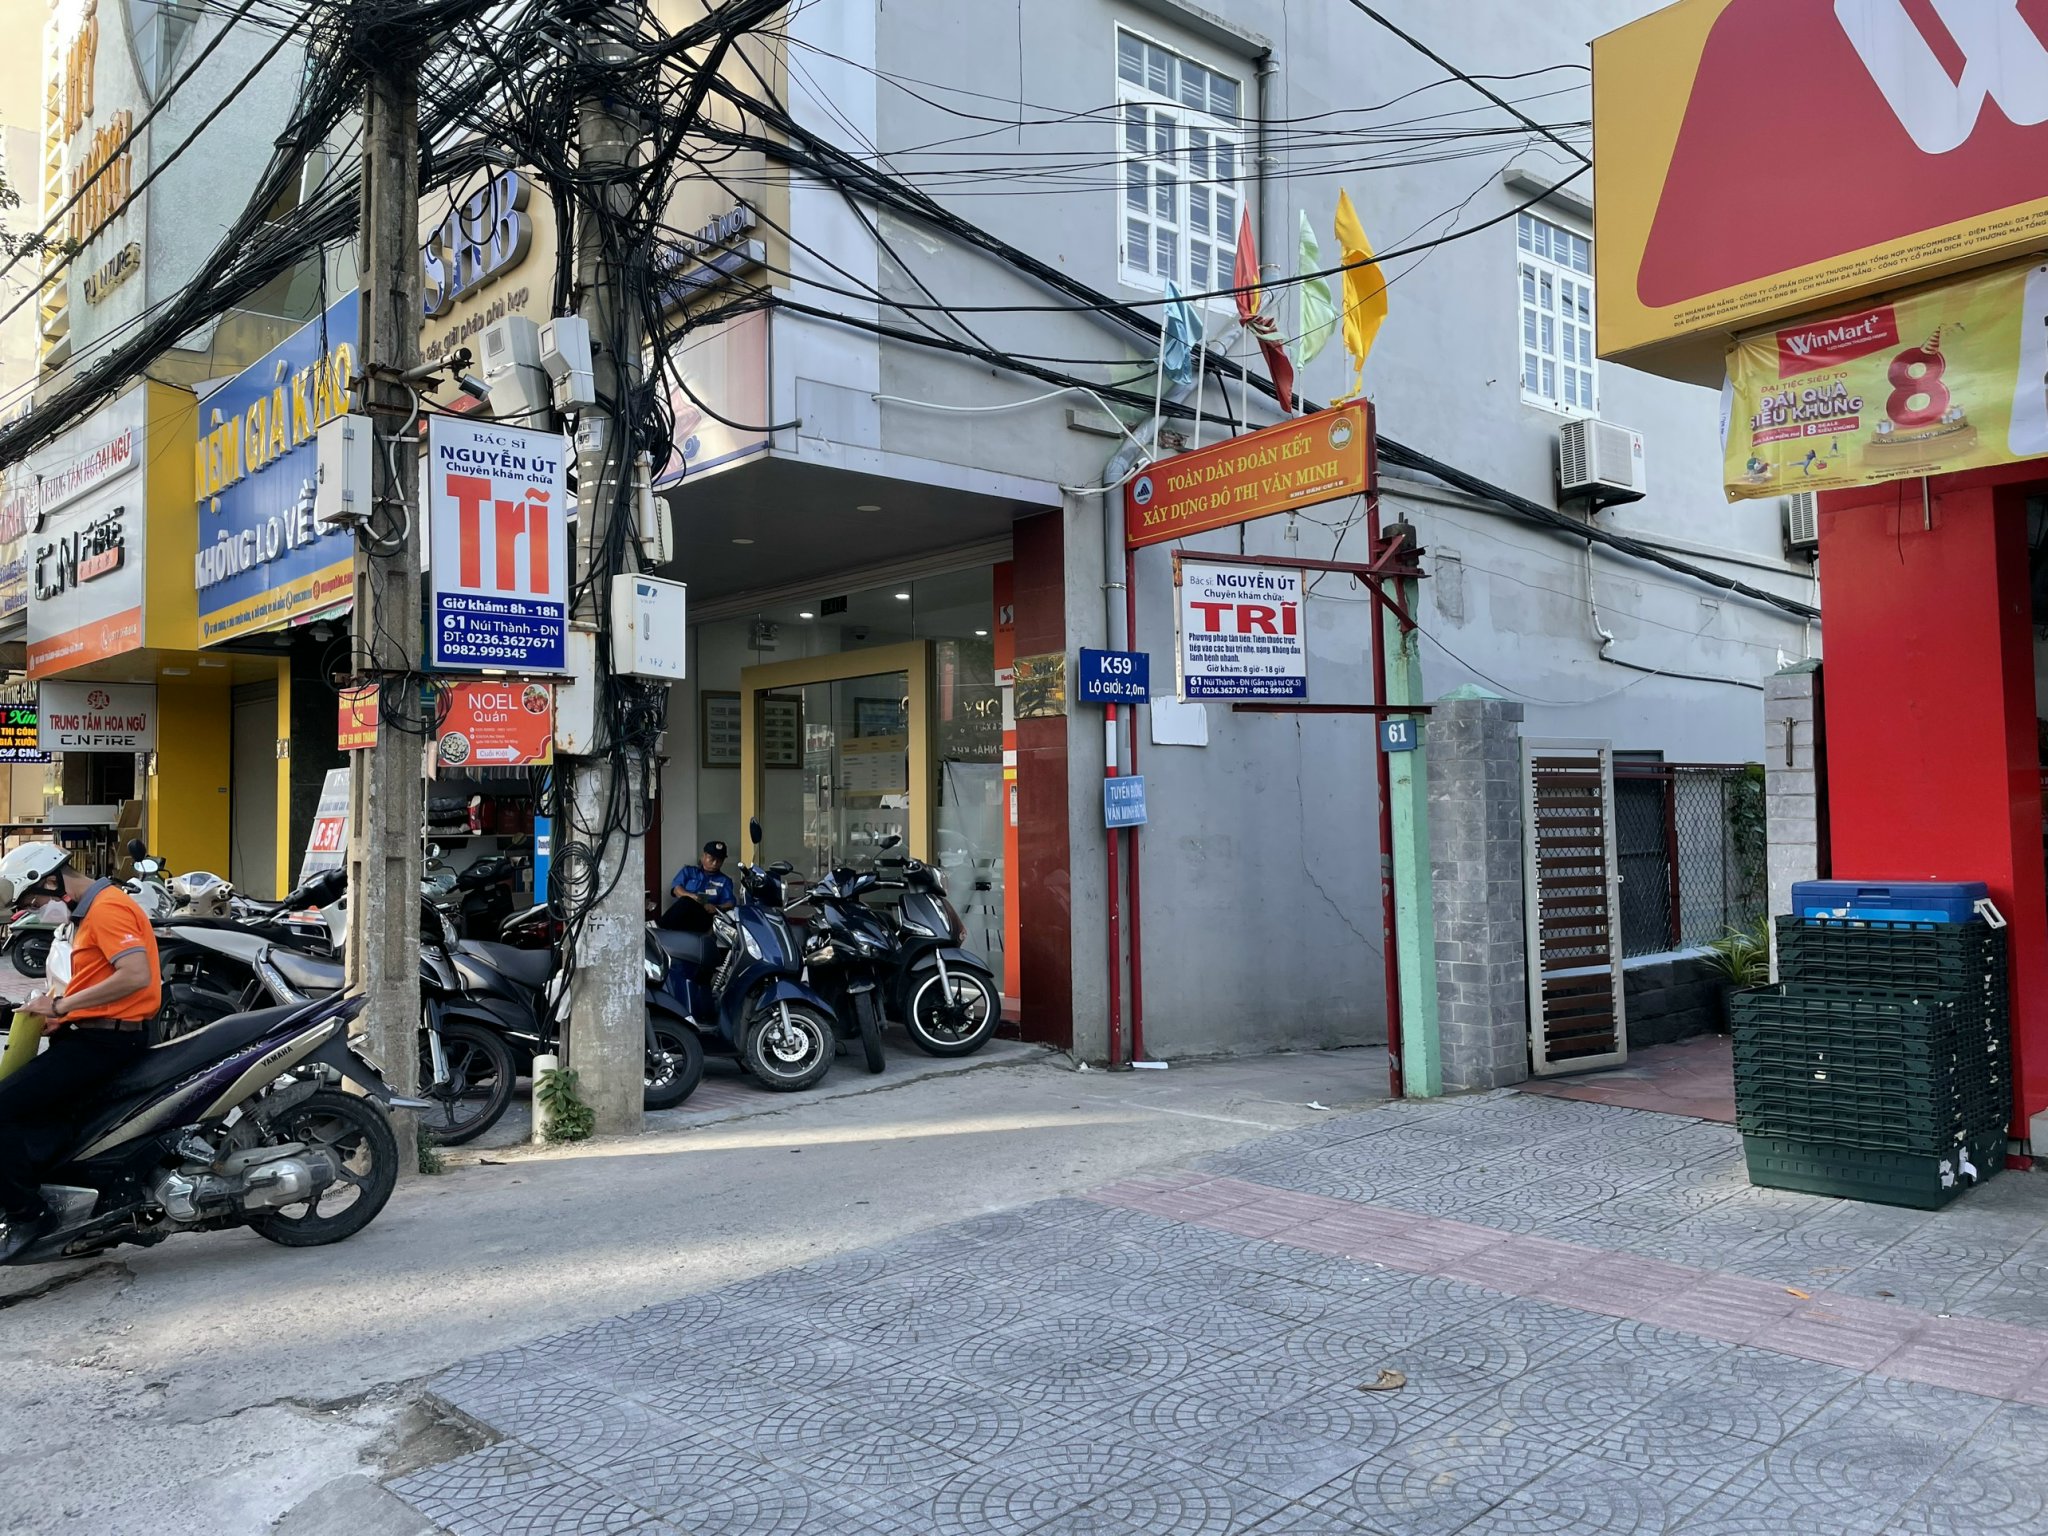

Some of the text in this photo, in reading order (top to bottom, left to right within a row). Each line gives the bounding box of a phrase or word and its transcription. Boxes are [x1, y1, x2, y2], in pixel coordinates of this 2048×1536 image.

[1674, 312, 1684, 320] CHI
[1685, 306, 1706, 318] NHÁNH
[1759, 289, 1767, 297] TY
[1825, 264, 1854, 278] THƯƠNG
[1906, 233, 1962, 254] WINCOMMERCE
[2015, 215, 2029, 224] 024
[1701, 311, 1716, 321] KINH
[1717, 305, 1738, 317] DOANH
[1816, 275, 1839, 287] NHÁNH
[1900, 256, 1909, 264] TY
[1976, 231, 2007, 243] THƯƠNG
[195, 360, 292, 514] NỆM GIÁ
[1807, 424, 1818, 435] 8
[473, 433, 526, 449] BÁC SĨ
[440, 445, 557, 474] NGUYỄN ÚT
[1168, 433, 1312, 493] TOÀN DÂN ĐOÀN KẾT
[446, 461, 553, 485] Chuyên khám chữa
[1143, 460, 1339, 527] XÂY DỰNG ĐÔ THỊ VĂN MINH
[446, 473, 551, 595] Trĩ
[195, 529, 256, 590] KHÔNG
[256, 516, 285, 563] LO
[1190, 575, 1205, 586] Bác
[1216, 572, 1274, 589] NGUYỄN
[1278, 575, 1295, 590] ÚT
[1204, 589, 1285, 601] Chuyên khám chữa:
[443, 597, 559, 617] Giờ khám: 8h 18h
[443, 614, 559, 636] 61 Núi Thành ĐN
[1190, 601, 1297, 635] TRĨ
[444, 631, 555, 649] ĐT: 0236.3627671
[1189, 633, 1212, 643] Phương
[443, 643, 527, 659] 0982.999345
[1272, 645, 1290, 655] Không
[1101, 656, 1132, 675] K59
[1206, 664, 1285, 675] Giờ khám: 8 giờ 18 giờ
[1089, 678, 1145, 696] LỘ GIỚI: 2,0m
[1190, 677, 1201, 685] 61
[1203, 678, 1214, 686] Núi
[1215, 679, 1235, 687] Thành
[1240, 679, 1250, 687] ĐN
[1202, 686, 1248, 695] 0236.3627671
[469, 693, 518, 710] NOEL
[50, 712, 146, 731] TRUNG TÂM HOA NGỮ
[473, 710, 508, 722] Quán
[1, 728, 15, 736] THI
[61, 734, 90, 746] C.N
[1388, 722, 1407, 743] 61
[18, 748, 42, 758] CNC
[1110, 781, 1130, 800] TUYẾN
[1107, 804, 1121, 821] VĂN
[261, 1045, 293, 1068] YAMAHA
